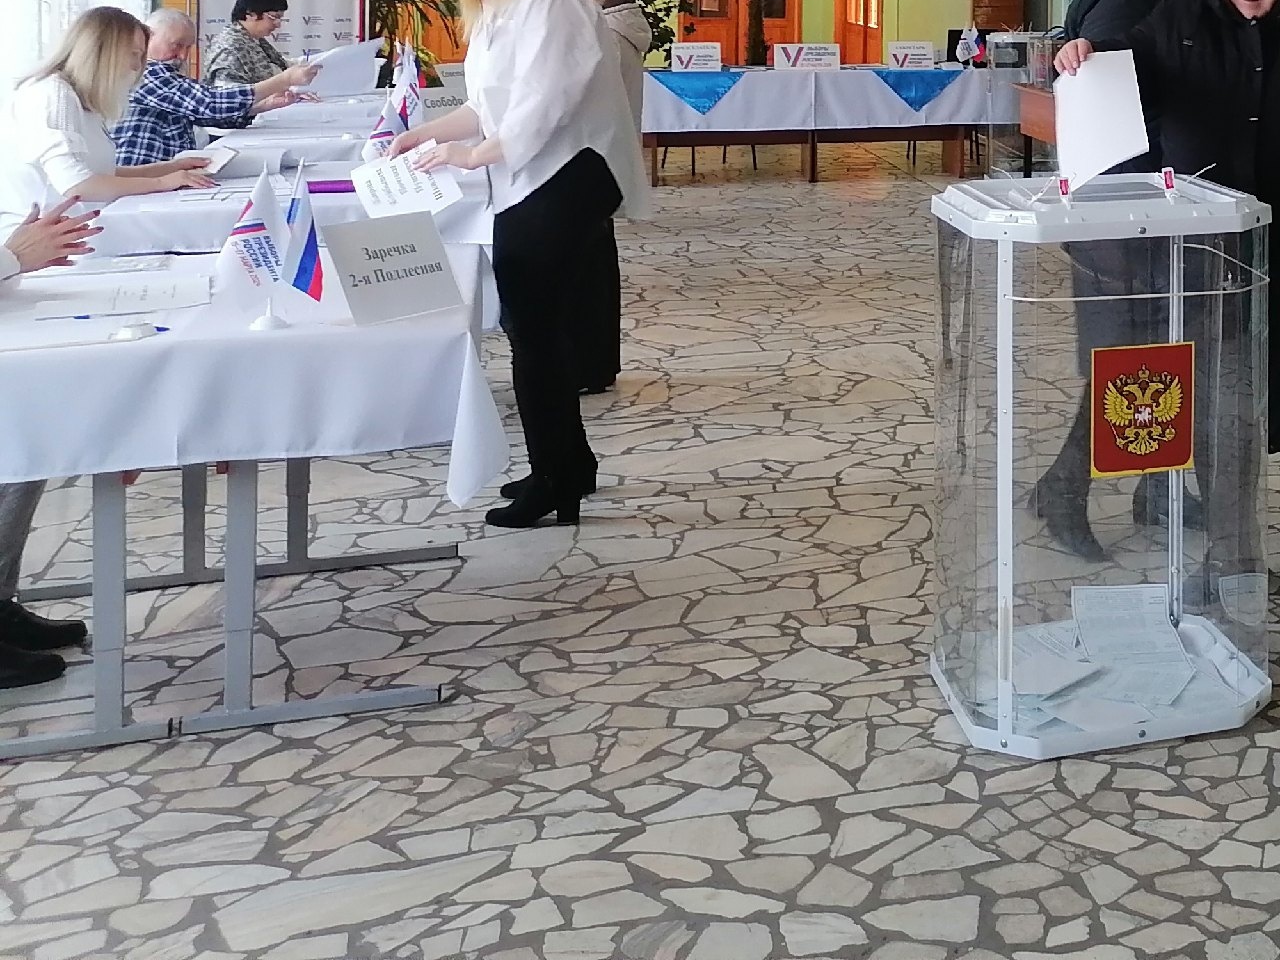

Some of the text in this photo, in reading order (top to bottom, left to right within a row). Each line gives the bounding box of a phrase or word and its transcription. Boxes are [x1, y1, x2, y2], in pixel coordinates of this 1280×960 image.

[241, 238, 263, 269] РОССИИ
[252, 236, 280, 283] ПРЕЗИДЕНТА
[263, 235, 282, 267] ВЫБОРЫ
[361, 243, 417, 263] Заречка
[348, 273, 373, 288] 2-я
